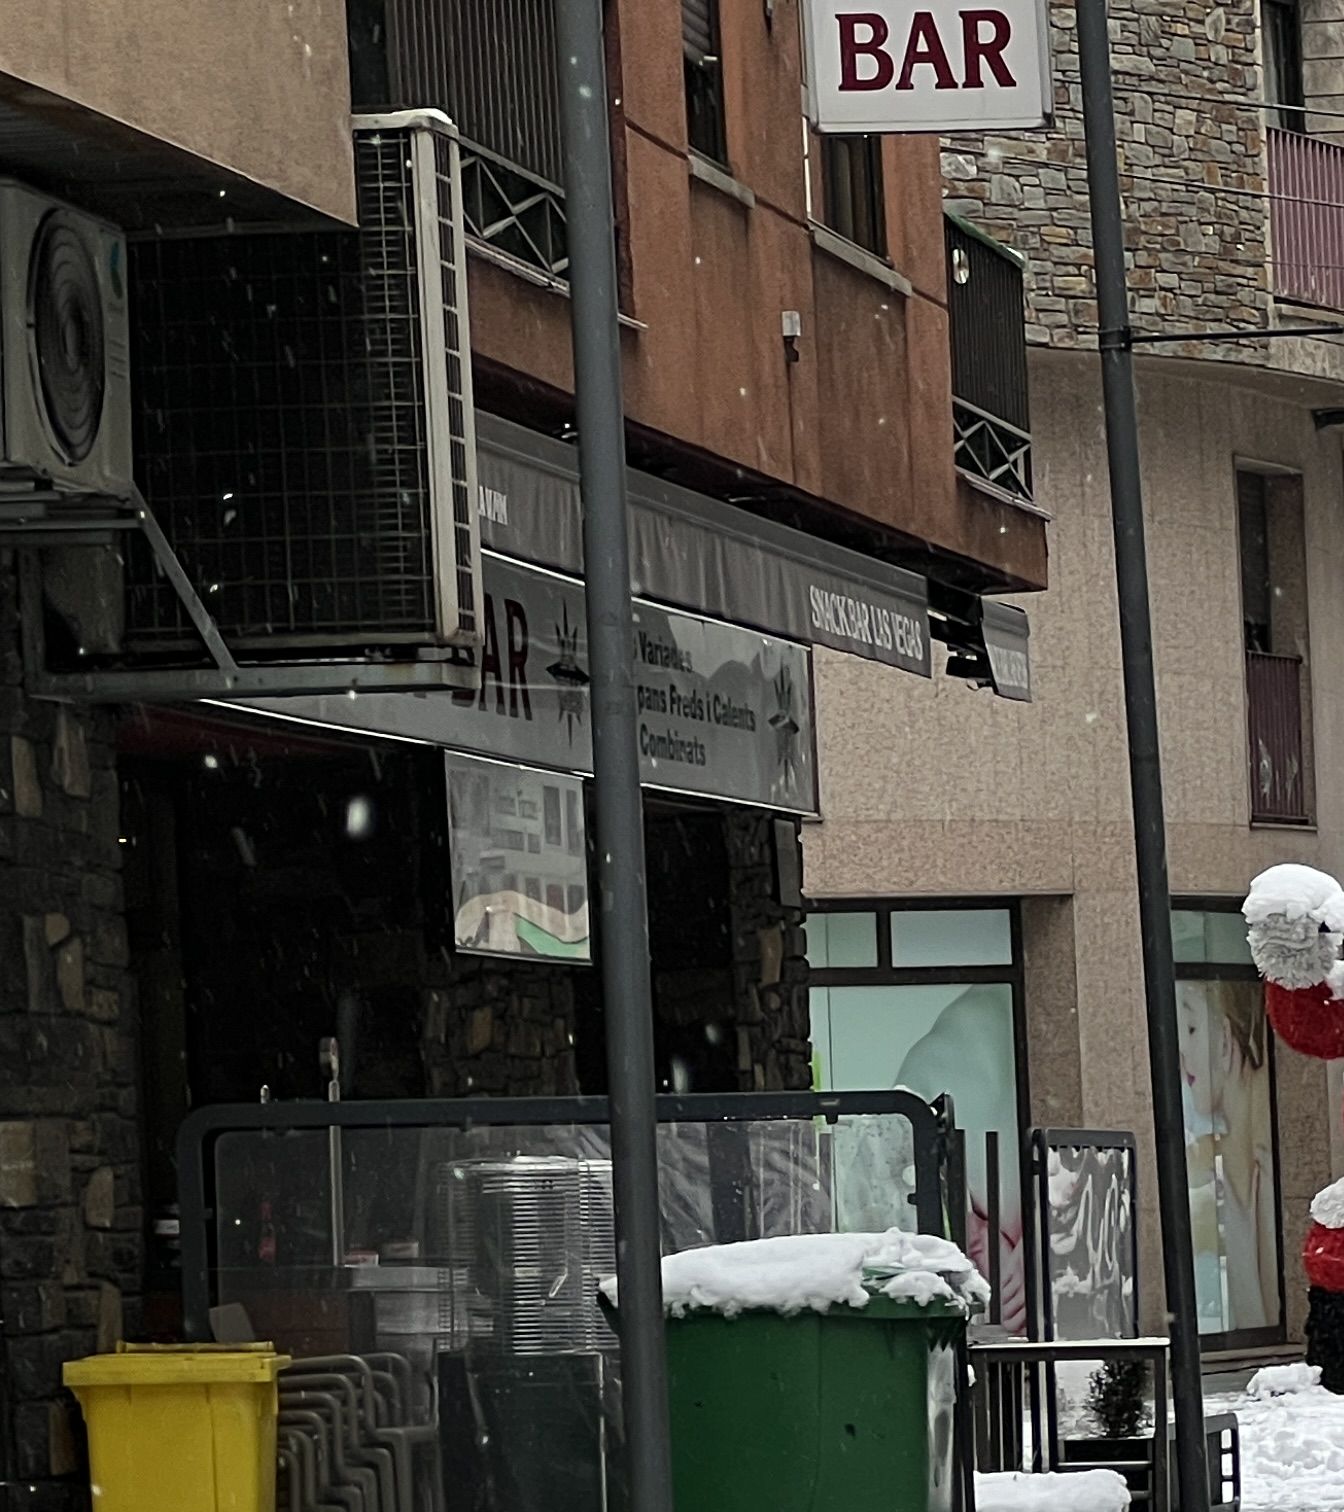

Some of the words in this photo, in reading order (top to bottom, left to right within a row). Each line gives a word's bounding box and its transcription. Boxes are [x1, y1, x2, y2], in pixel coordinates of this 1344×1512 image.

[834, 9, 1017, 91] BAR
[809, 584, 852, 637] SNACK
[847, 597, 873, 644] BAR
[870, 604, 892, 651] LAS
[890, 610, 923, 661] VEGAS
[669, 684, 704, 721] Freds
